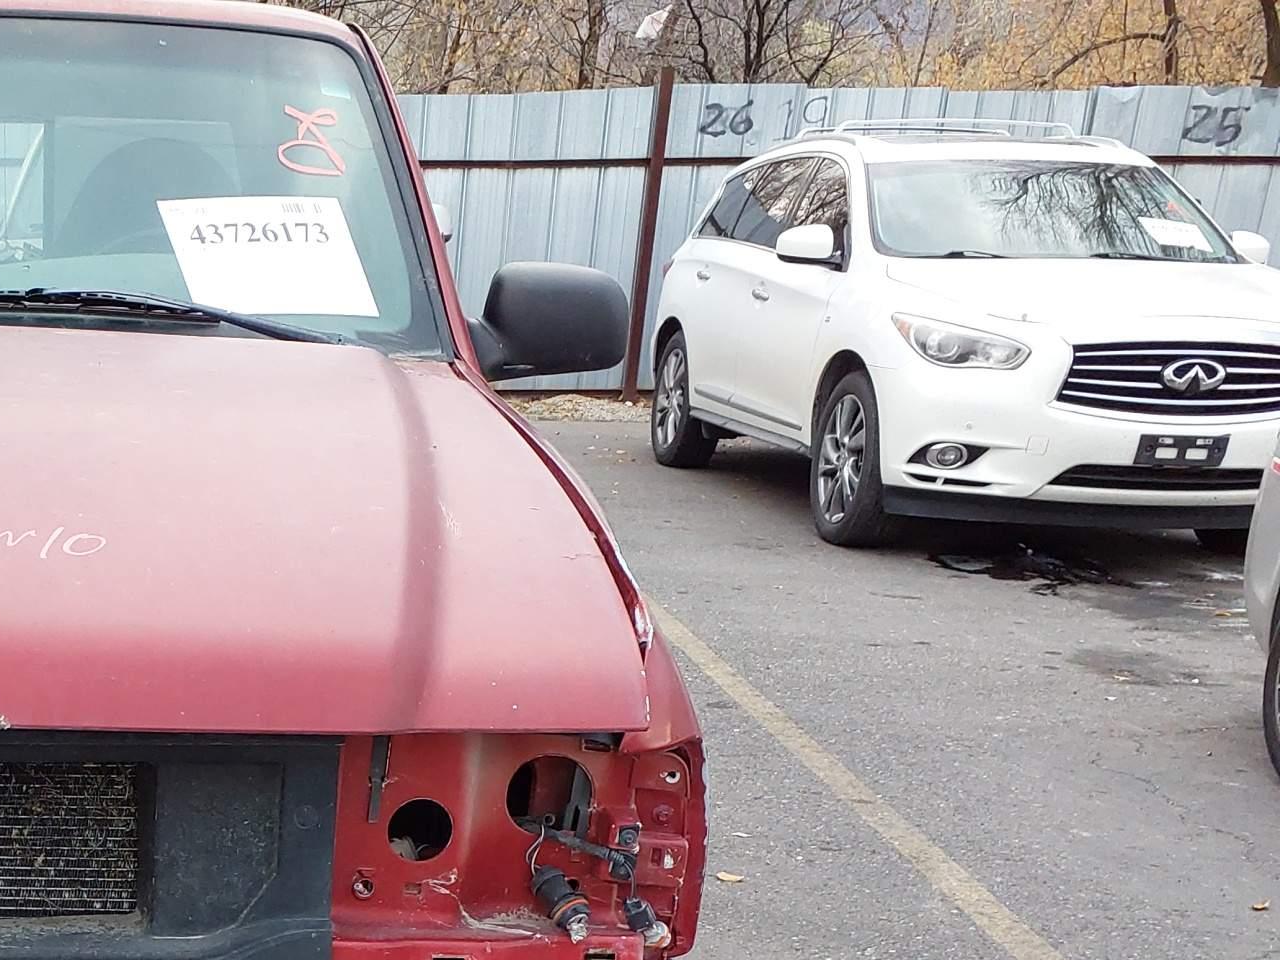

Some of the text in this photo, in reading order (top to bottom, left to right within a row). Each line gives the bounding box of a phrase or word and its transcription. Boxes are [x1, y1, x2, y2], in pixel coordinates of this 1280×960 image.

[699, 99, 754, 138] 26
[1181, 104, 1251, 147] 25
[189, 221, 330, 245] 43726173
